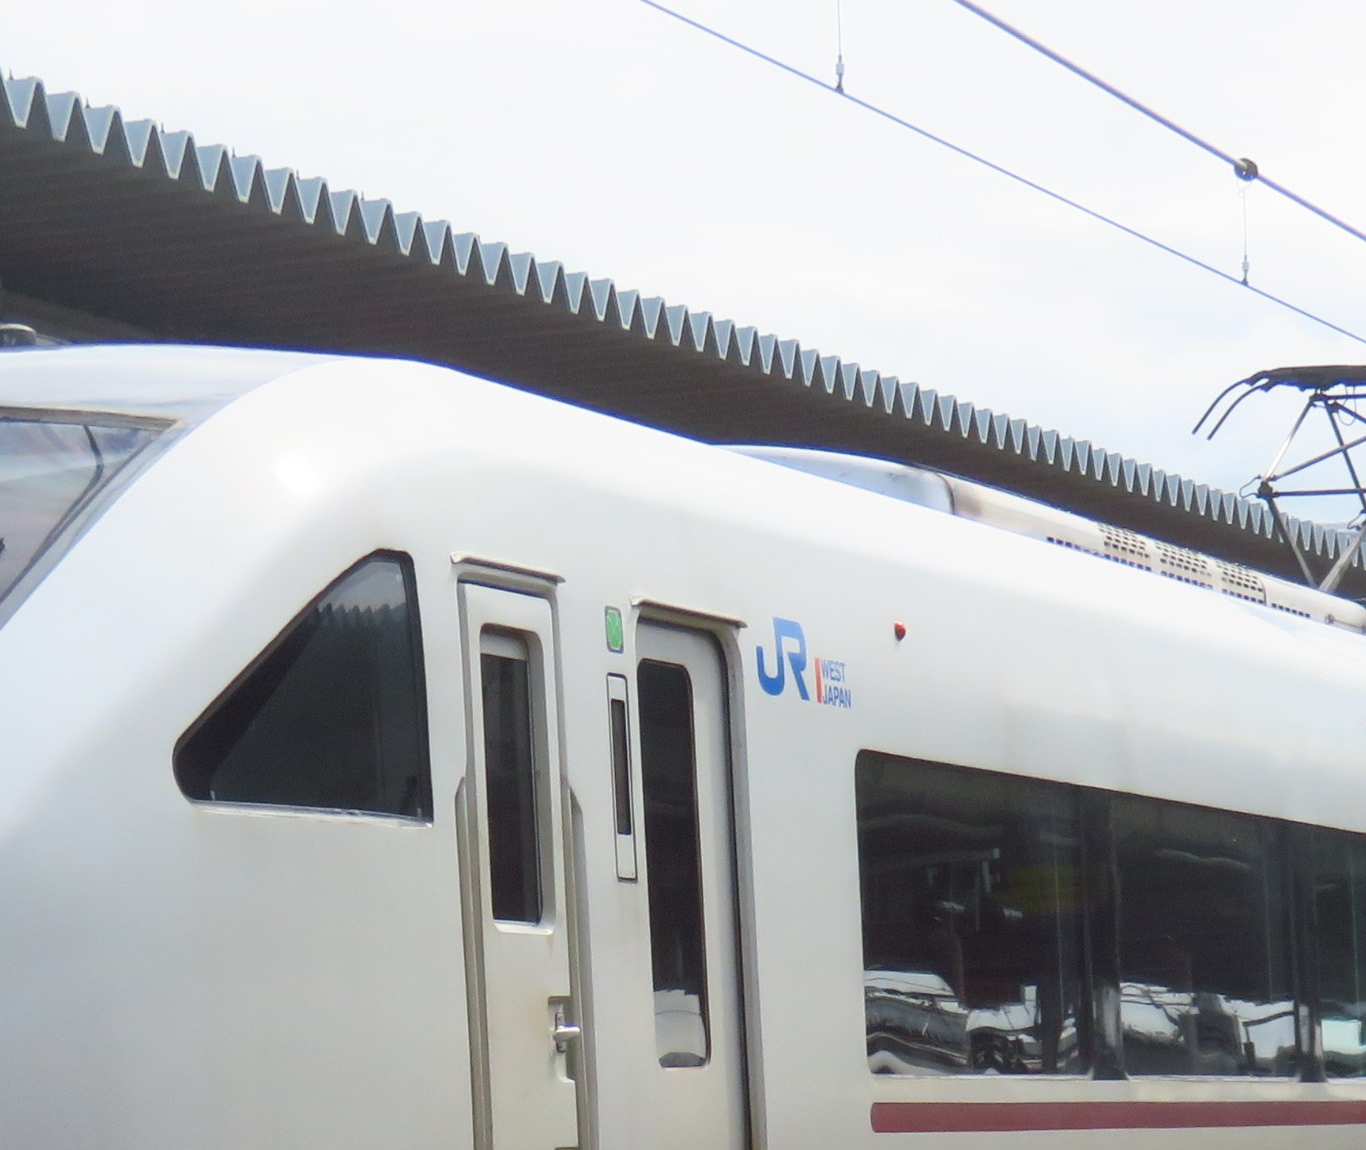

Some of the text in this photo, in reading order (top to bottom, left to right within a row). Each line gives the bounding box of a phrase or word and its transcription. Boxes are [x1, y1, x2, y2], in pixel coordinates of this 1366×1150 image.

[756, 617, 810, 701] JR
[822, 659, 845, 682] WEST
[822, 685, 851, 708] JAPAN
